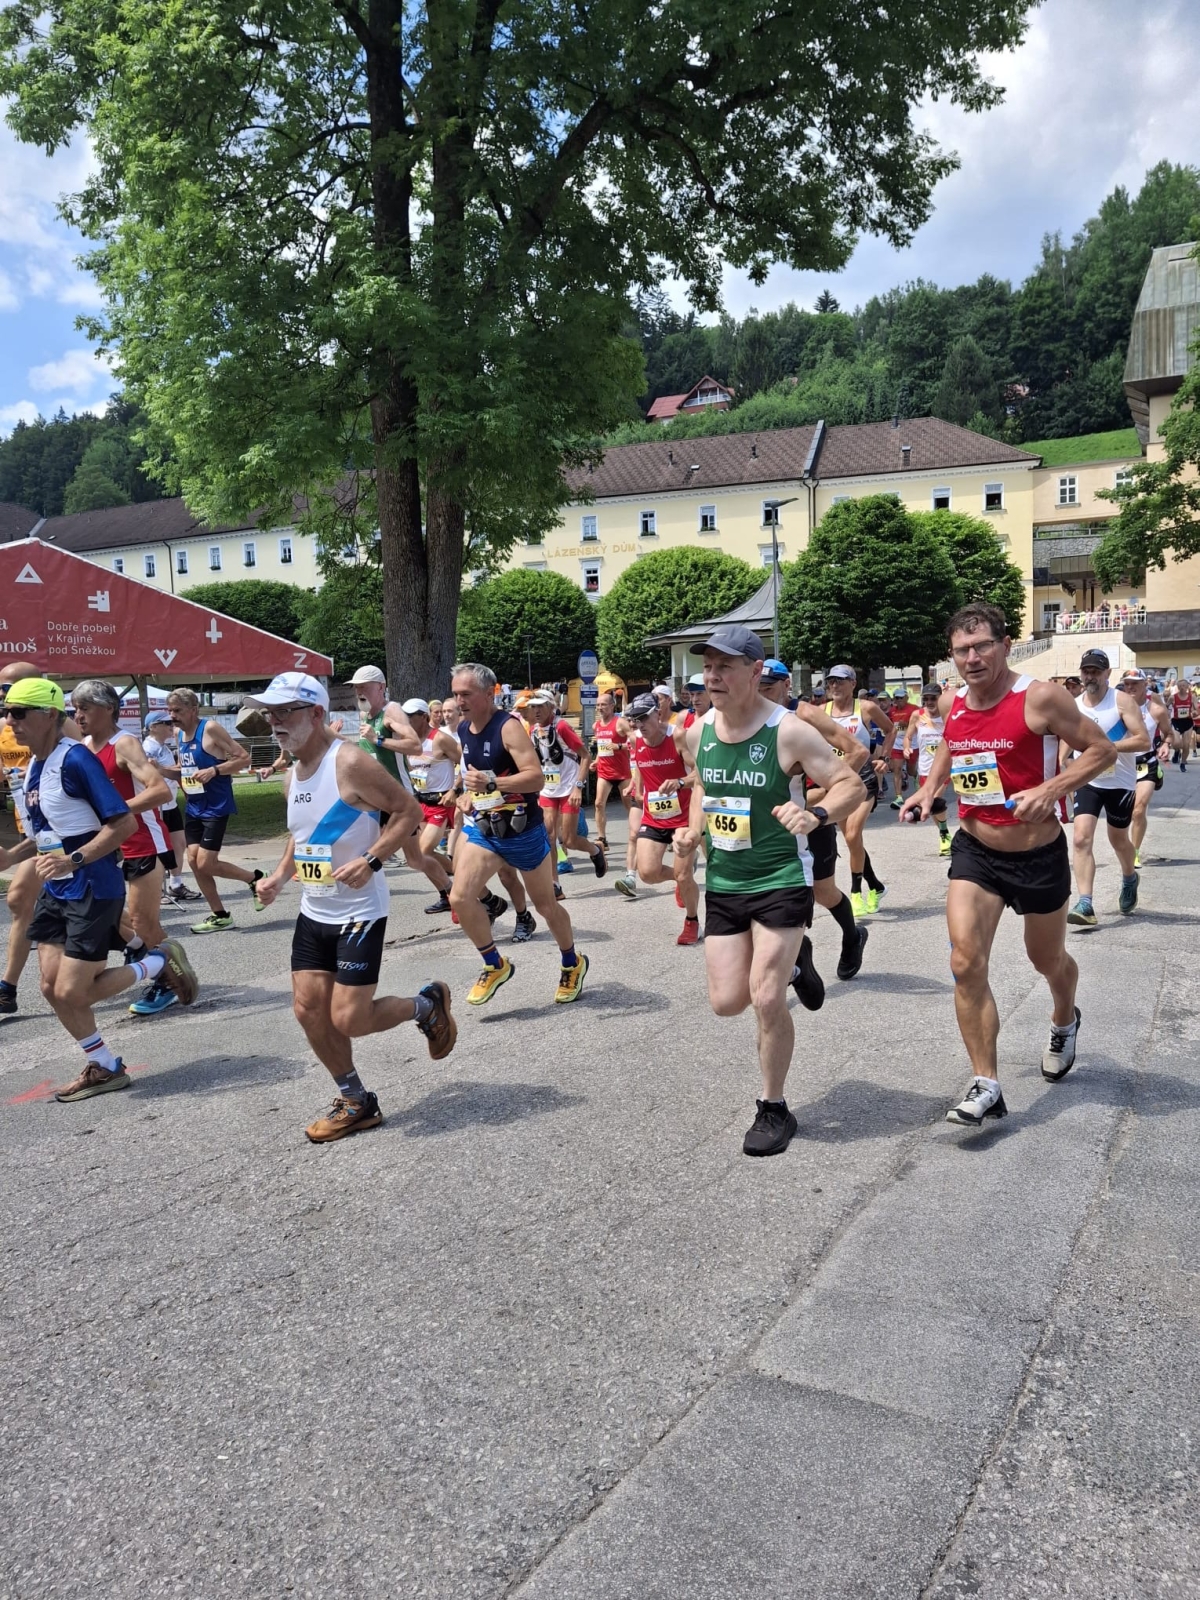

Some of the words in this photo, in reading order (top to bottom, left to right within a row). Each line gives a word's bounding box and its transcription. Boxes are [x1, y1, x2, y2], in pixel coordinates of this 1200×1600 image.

[47, 621, 79, 631] Dobře
[82, 623, 116, 634] pobejt
[56, 634, 93, 644] Krajině
[49, 646, 68, 655] pod
[71, 645, 116, 655] Sněžkou
[949, 739, 1014, 750] CzechRepublic
[703, 768, 767, 787] IRELAND
[960, 772, 989, 789] 295
[294, 792, 312, 805] ARG
[655, 800, 672, 811] 362
[715, 814, 737, 832] 656
[302, 863, 322, 879] 176
